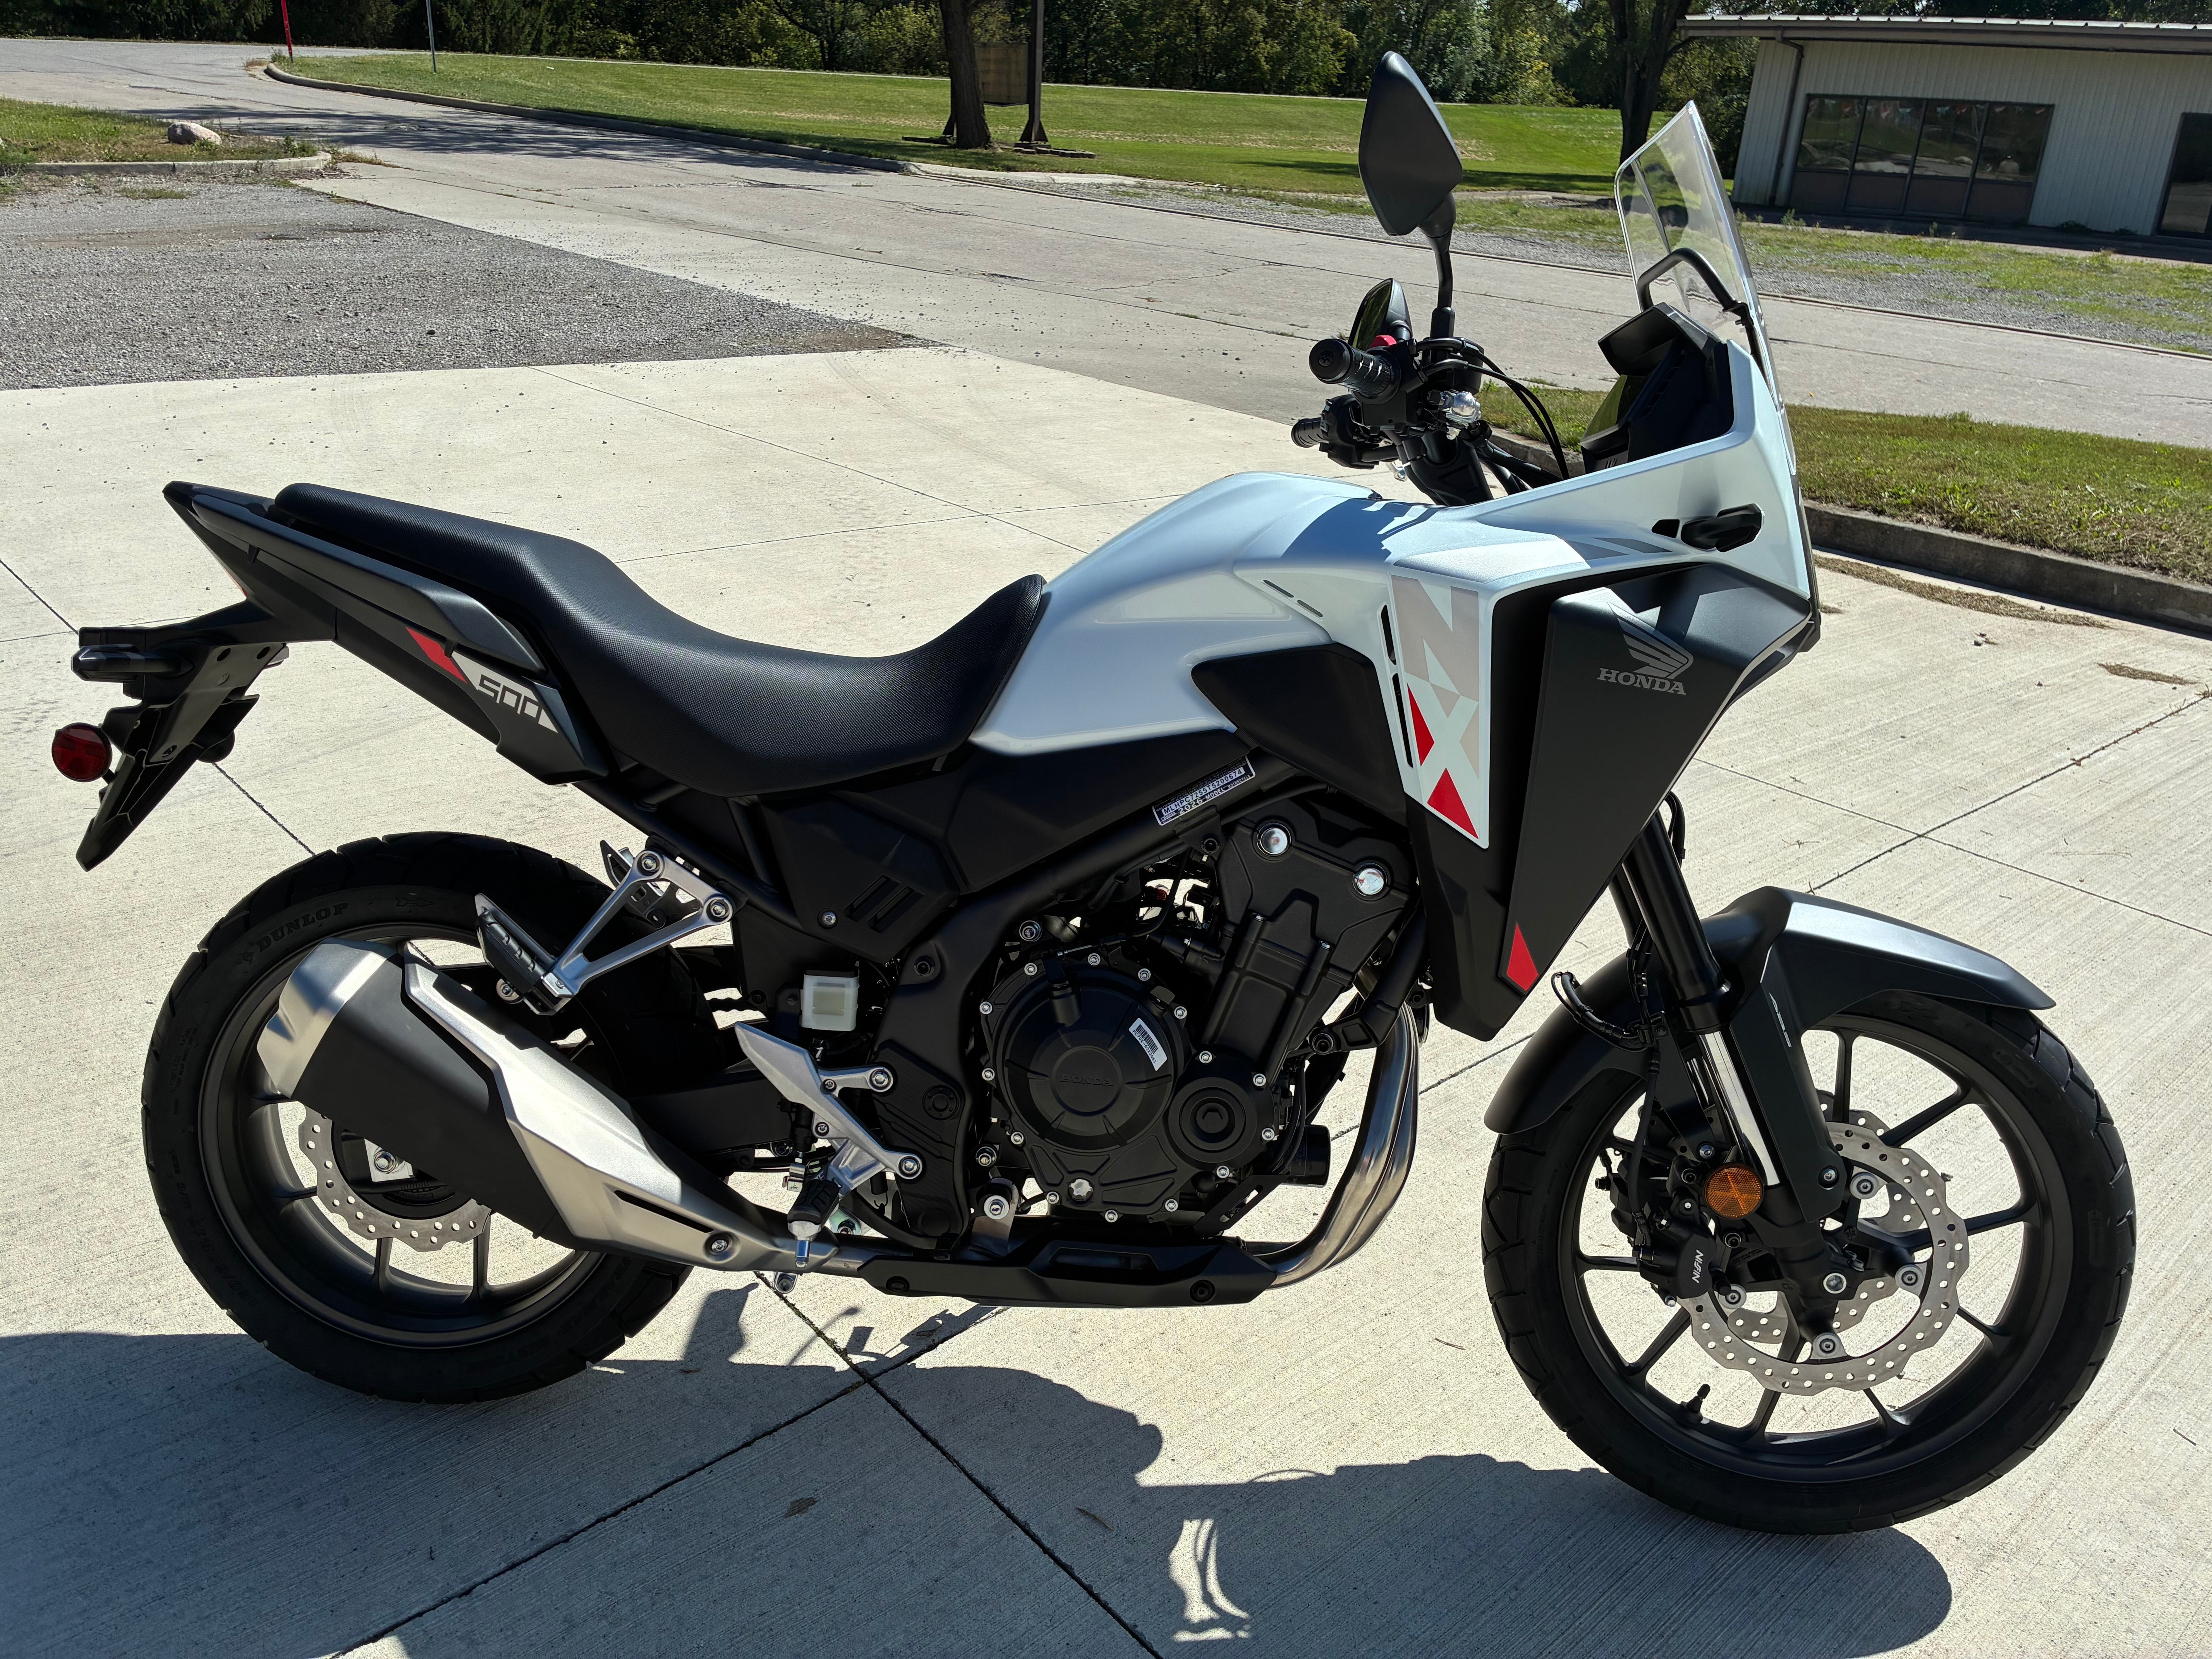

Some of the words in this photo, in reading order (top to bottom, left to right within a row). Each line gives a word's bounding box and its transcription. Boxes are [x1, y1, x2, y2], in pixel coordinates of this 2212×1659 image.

[479, 674, 544, 724] 500
[1597, 668, 1686, 695] HONDA
[1163, 769, 1242, 814] MLHPC7255T5200674
[1178, 798, 1203, 814] 2026
[1205, 787, 1225, 800] MODEL
[256, 902, 348, 952] DUNLOP
[1060, 1075, 1114, 1087] HONDA
